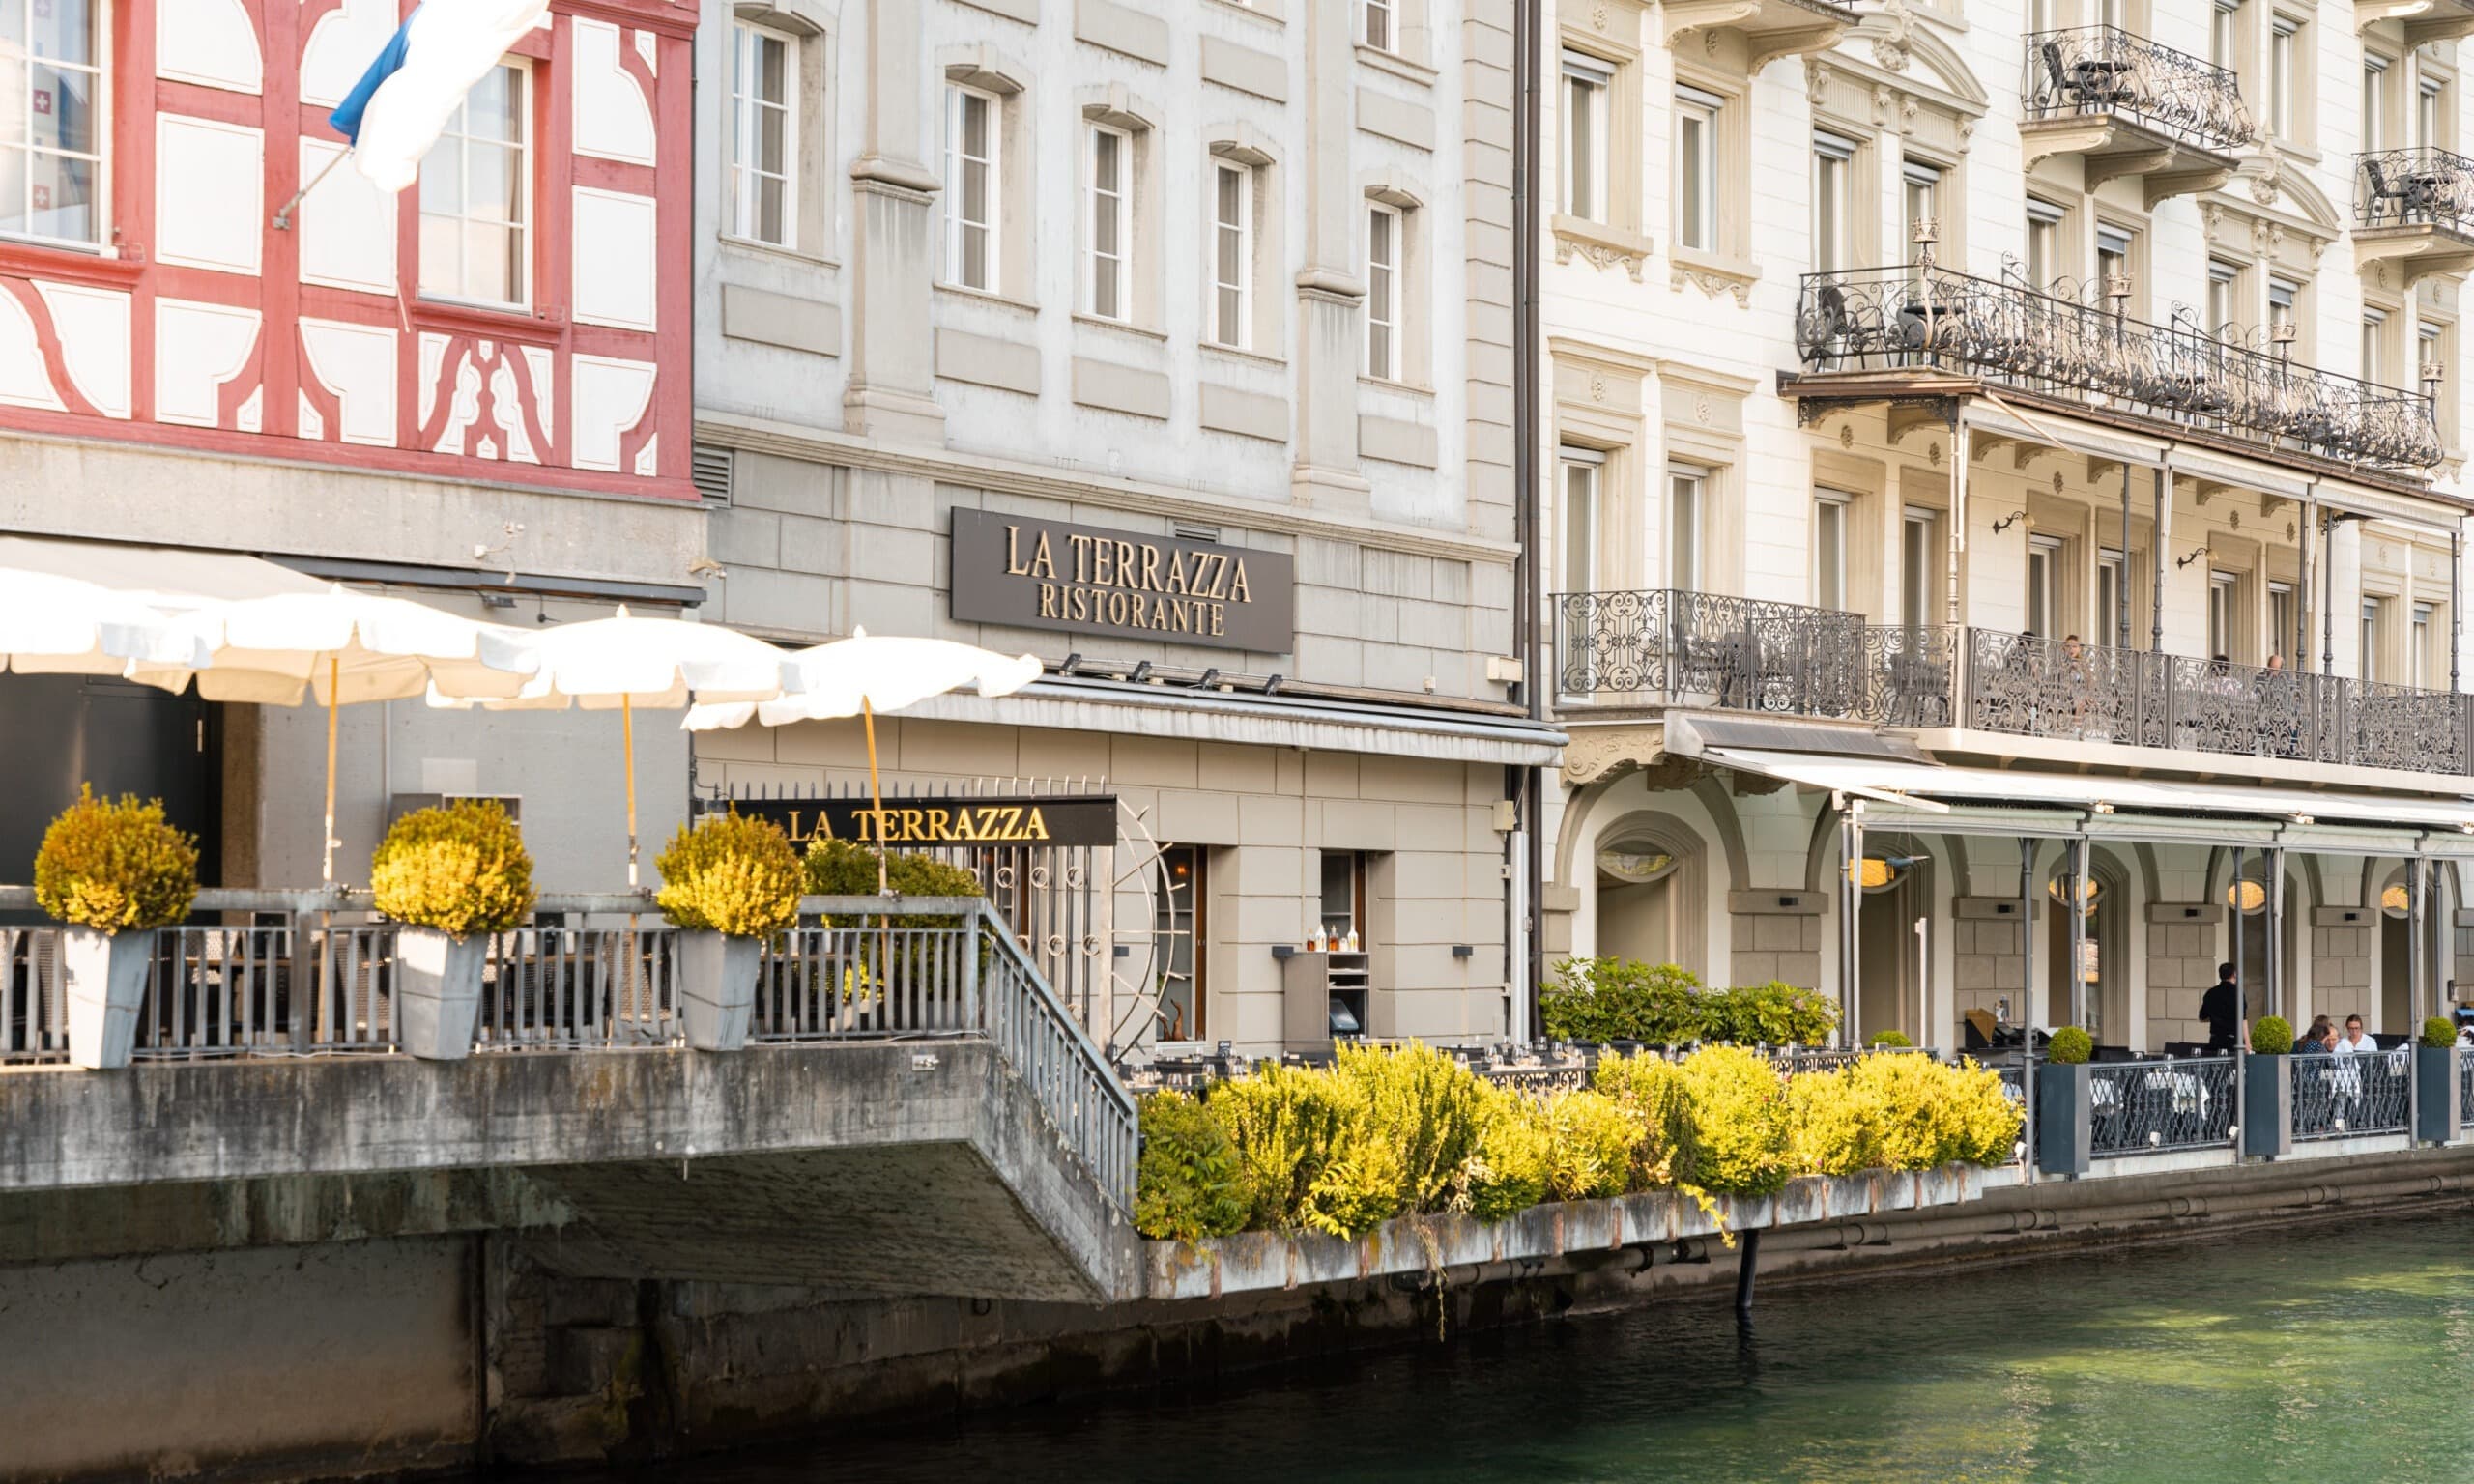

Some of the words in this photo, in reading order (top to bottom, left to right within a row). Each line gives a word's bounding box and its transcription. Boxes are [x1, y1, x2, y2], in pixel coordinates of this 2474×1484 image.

[1006, 525, 1057, 580] LA
[1069, 533, 1252, 603] TERRAZZA
[1040, 583, 1224, 637] RISTORANTE
[788, 810, 832, 842] LA
[851, 807, 1050, 841] TERRAZZA
